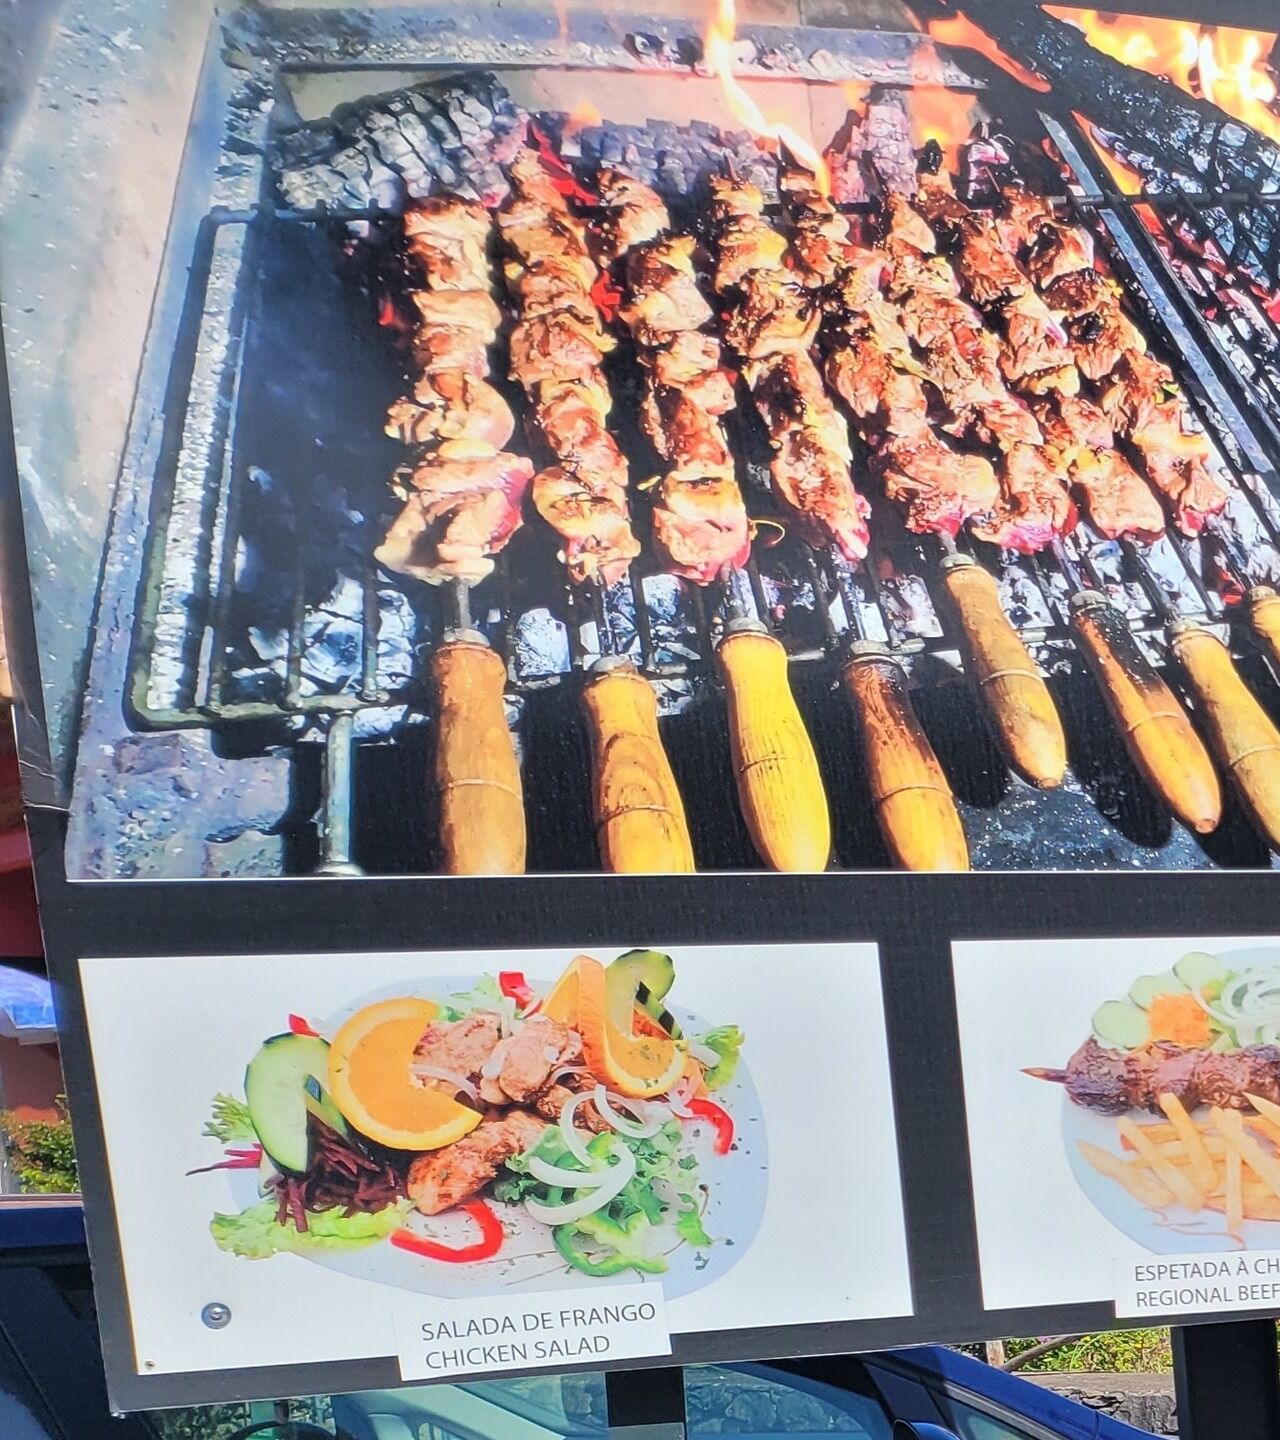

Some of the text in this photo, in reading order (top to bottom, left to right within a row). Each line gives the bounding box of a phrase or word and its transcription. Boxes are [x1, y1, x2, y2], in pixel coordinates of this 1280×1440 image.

[1135, 1262, 1230, 1282] ESPETADA
[1236, 1256, 1249, 1276] À
[1136, 1286, 1233, 1307] REGIONAL
[1238, 1283, 1280, 1301] BEEF
[421, 1303, 656, 1341] SALADA DE FRANGO
[426, 1335, 610, 1369] CHICKEN SALAD
